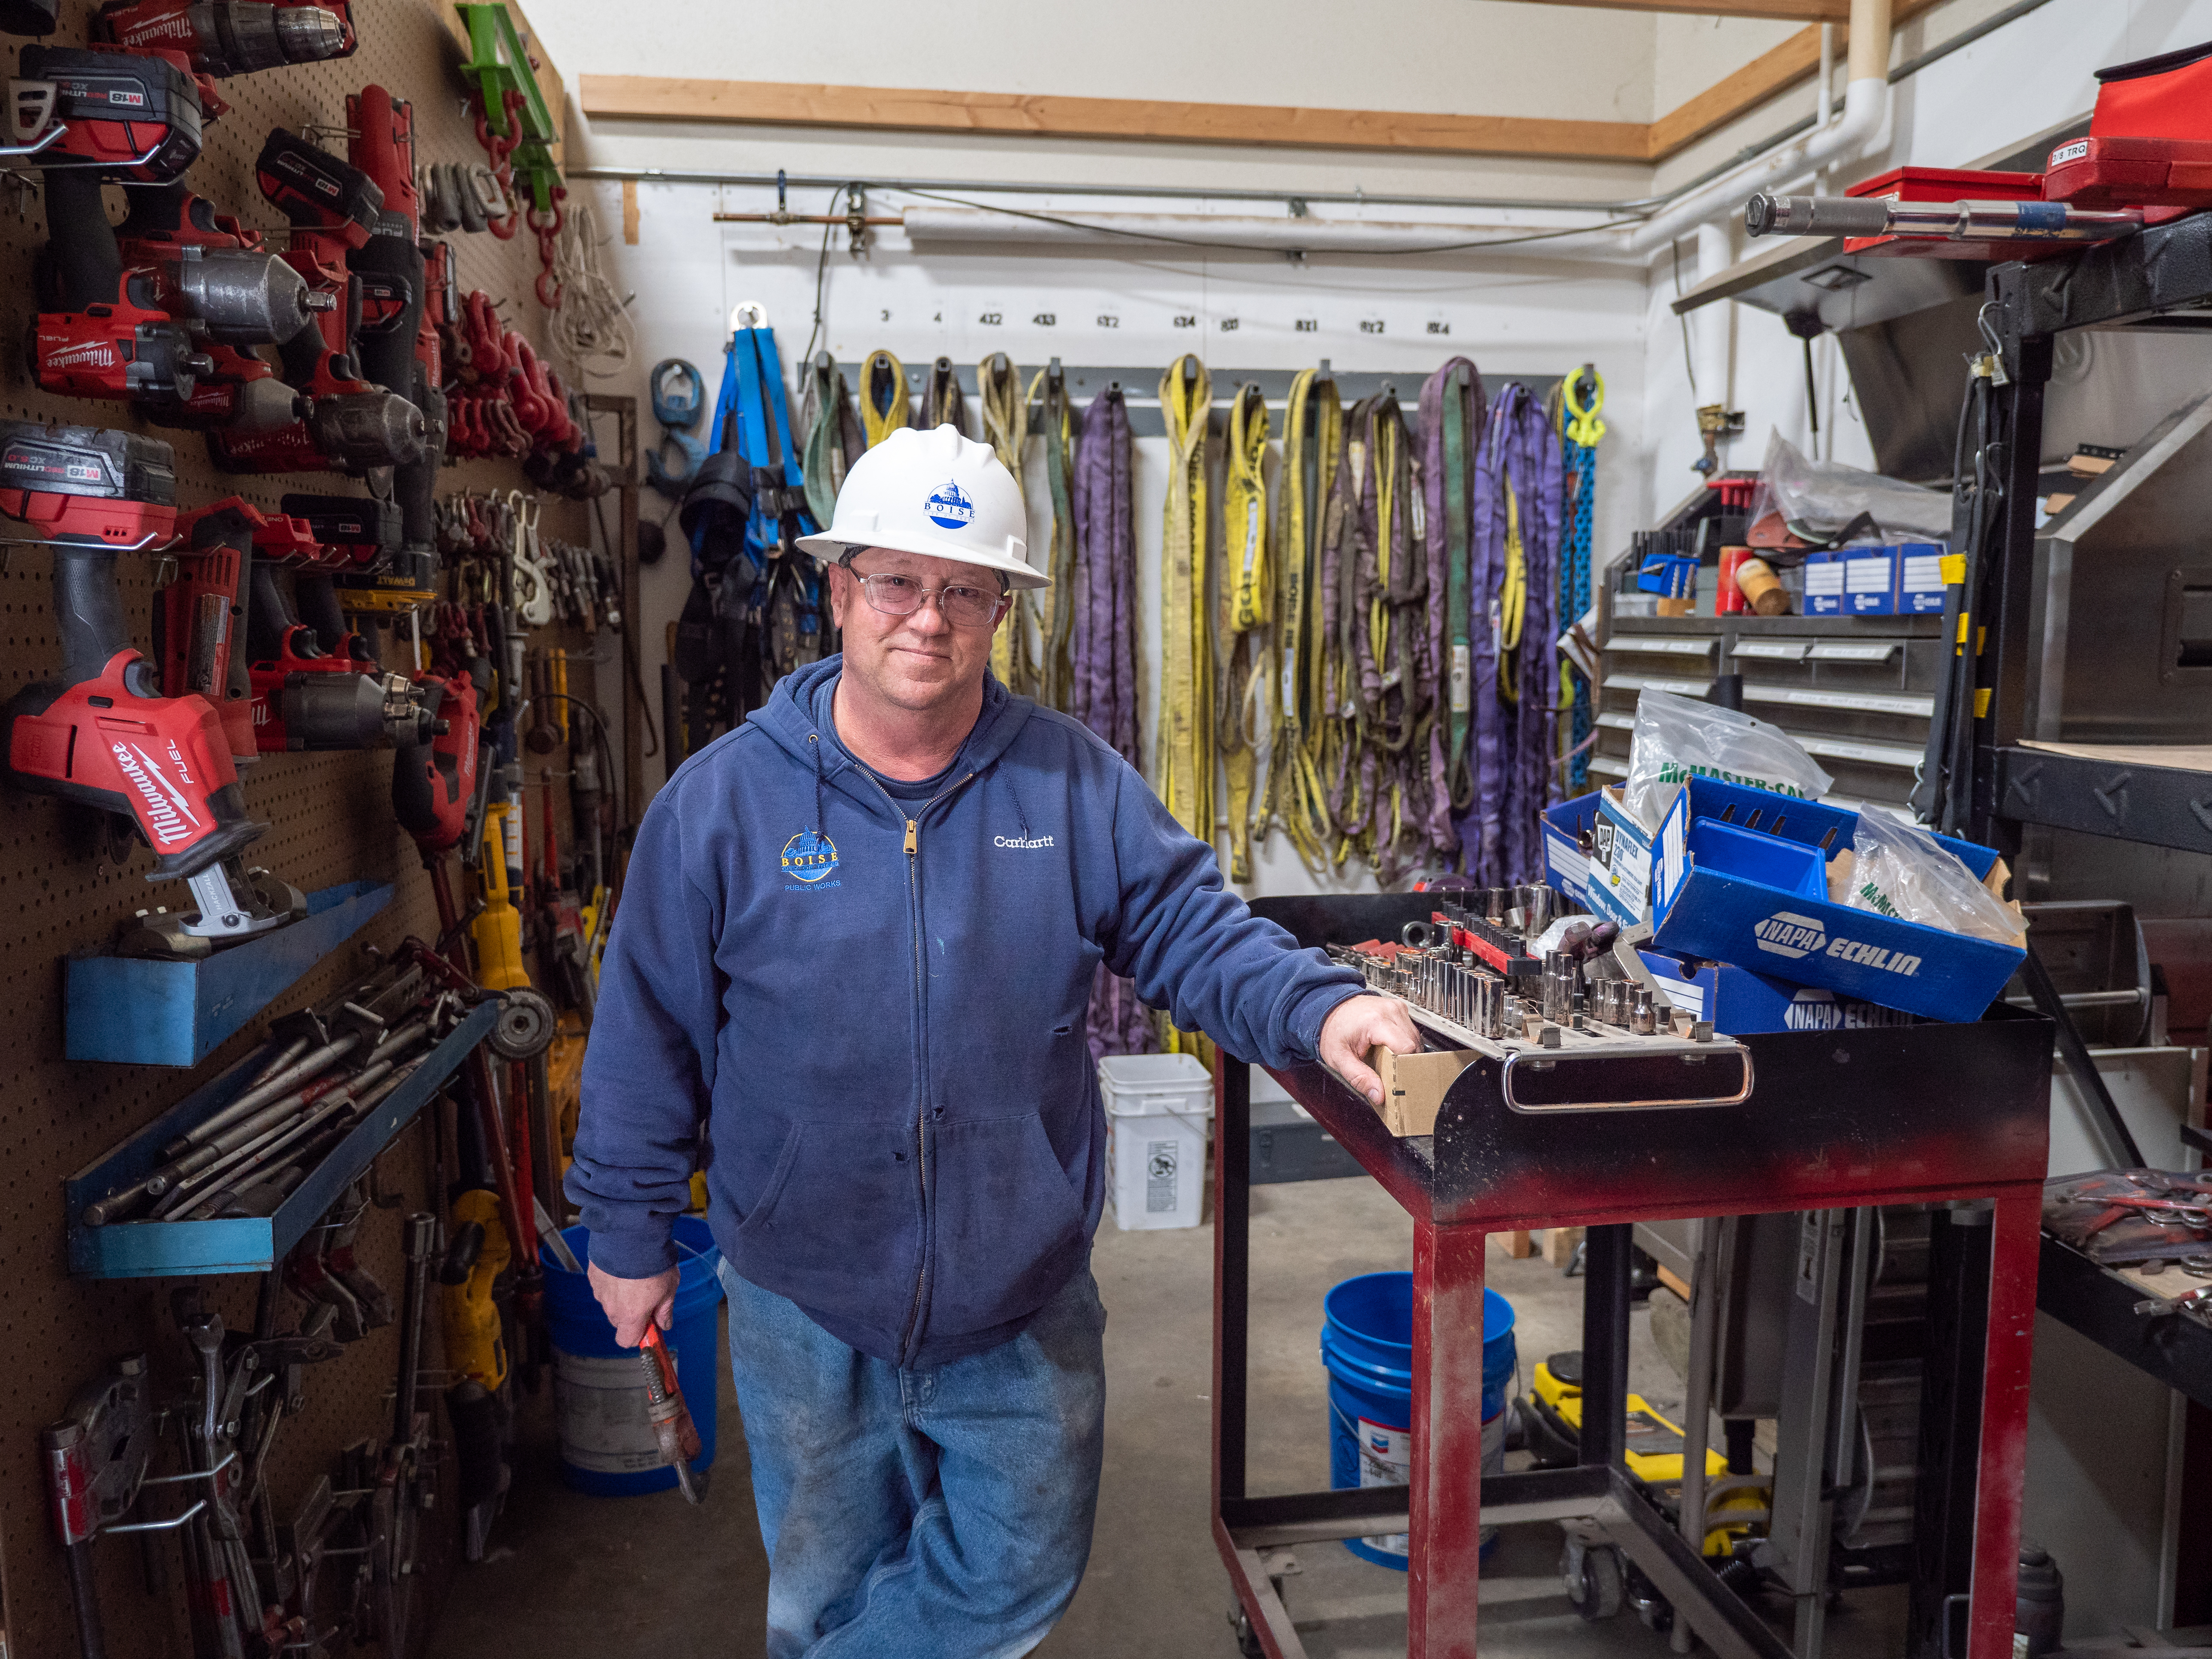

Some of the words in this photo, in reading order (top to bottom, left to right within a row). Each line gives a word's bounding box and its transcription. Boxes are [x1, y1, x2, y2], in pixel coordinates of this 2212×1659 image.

[122, 17, 193, 46] Milwaukee
[112, 93, 141, 104] M18
[2053, 152, 2064, 162] 3/8
[2067, 145, 2085, 156] TRQ
[46, 348, 116, 368] Milwaukee
[69, 467, 99, 478] M18
[924, 503, 975, 518] BOISE
[167, 739, 194, 783] FUEL
[113, 741, 193, 845] Milwaukee
[994, 835, 1055, 849] Carhartt
[1616, 829, 1639, 861] DYNAFLEX
[781, 852, 838, 867] BOISE
[1613, 843, 1623, 862] 230
[203, 873, 223, 910] HACKZALL
[814, 880, 841, 891] WORKS
[1588, 884, 1606, 915] Window,
[1606, 903, 1618, 922] Door
[1617, 915, 1622, 927] &
[1763, 921, 1817, 951] NAPA
[1826, 937, 1922, 977] ECHLIN
[1794, 1003, 1833, 1030] NAPA
